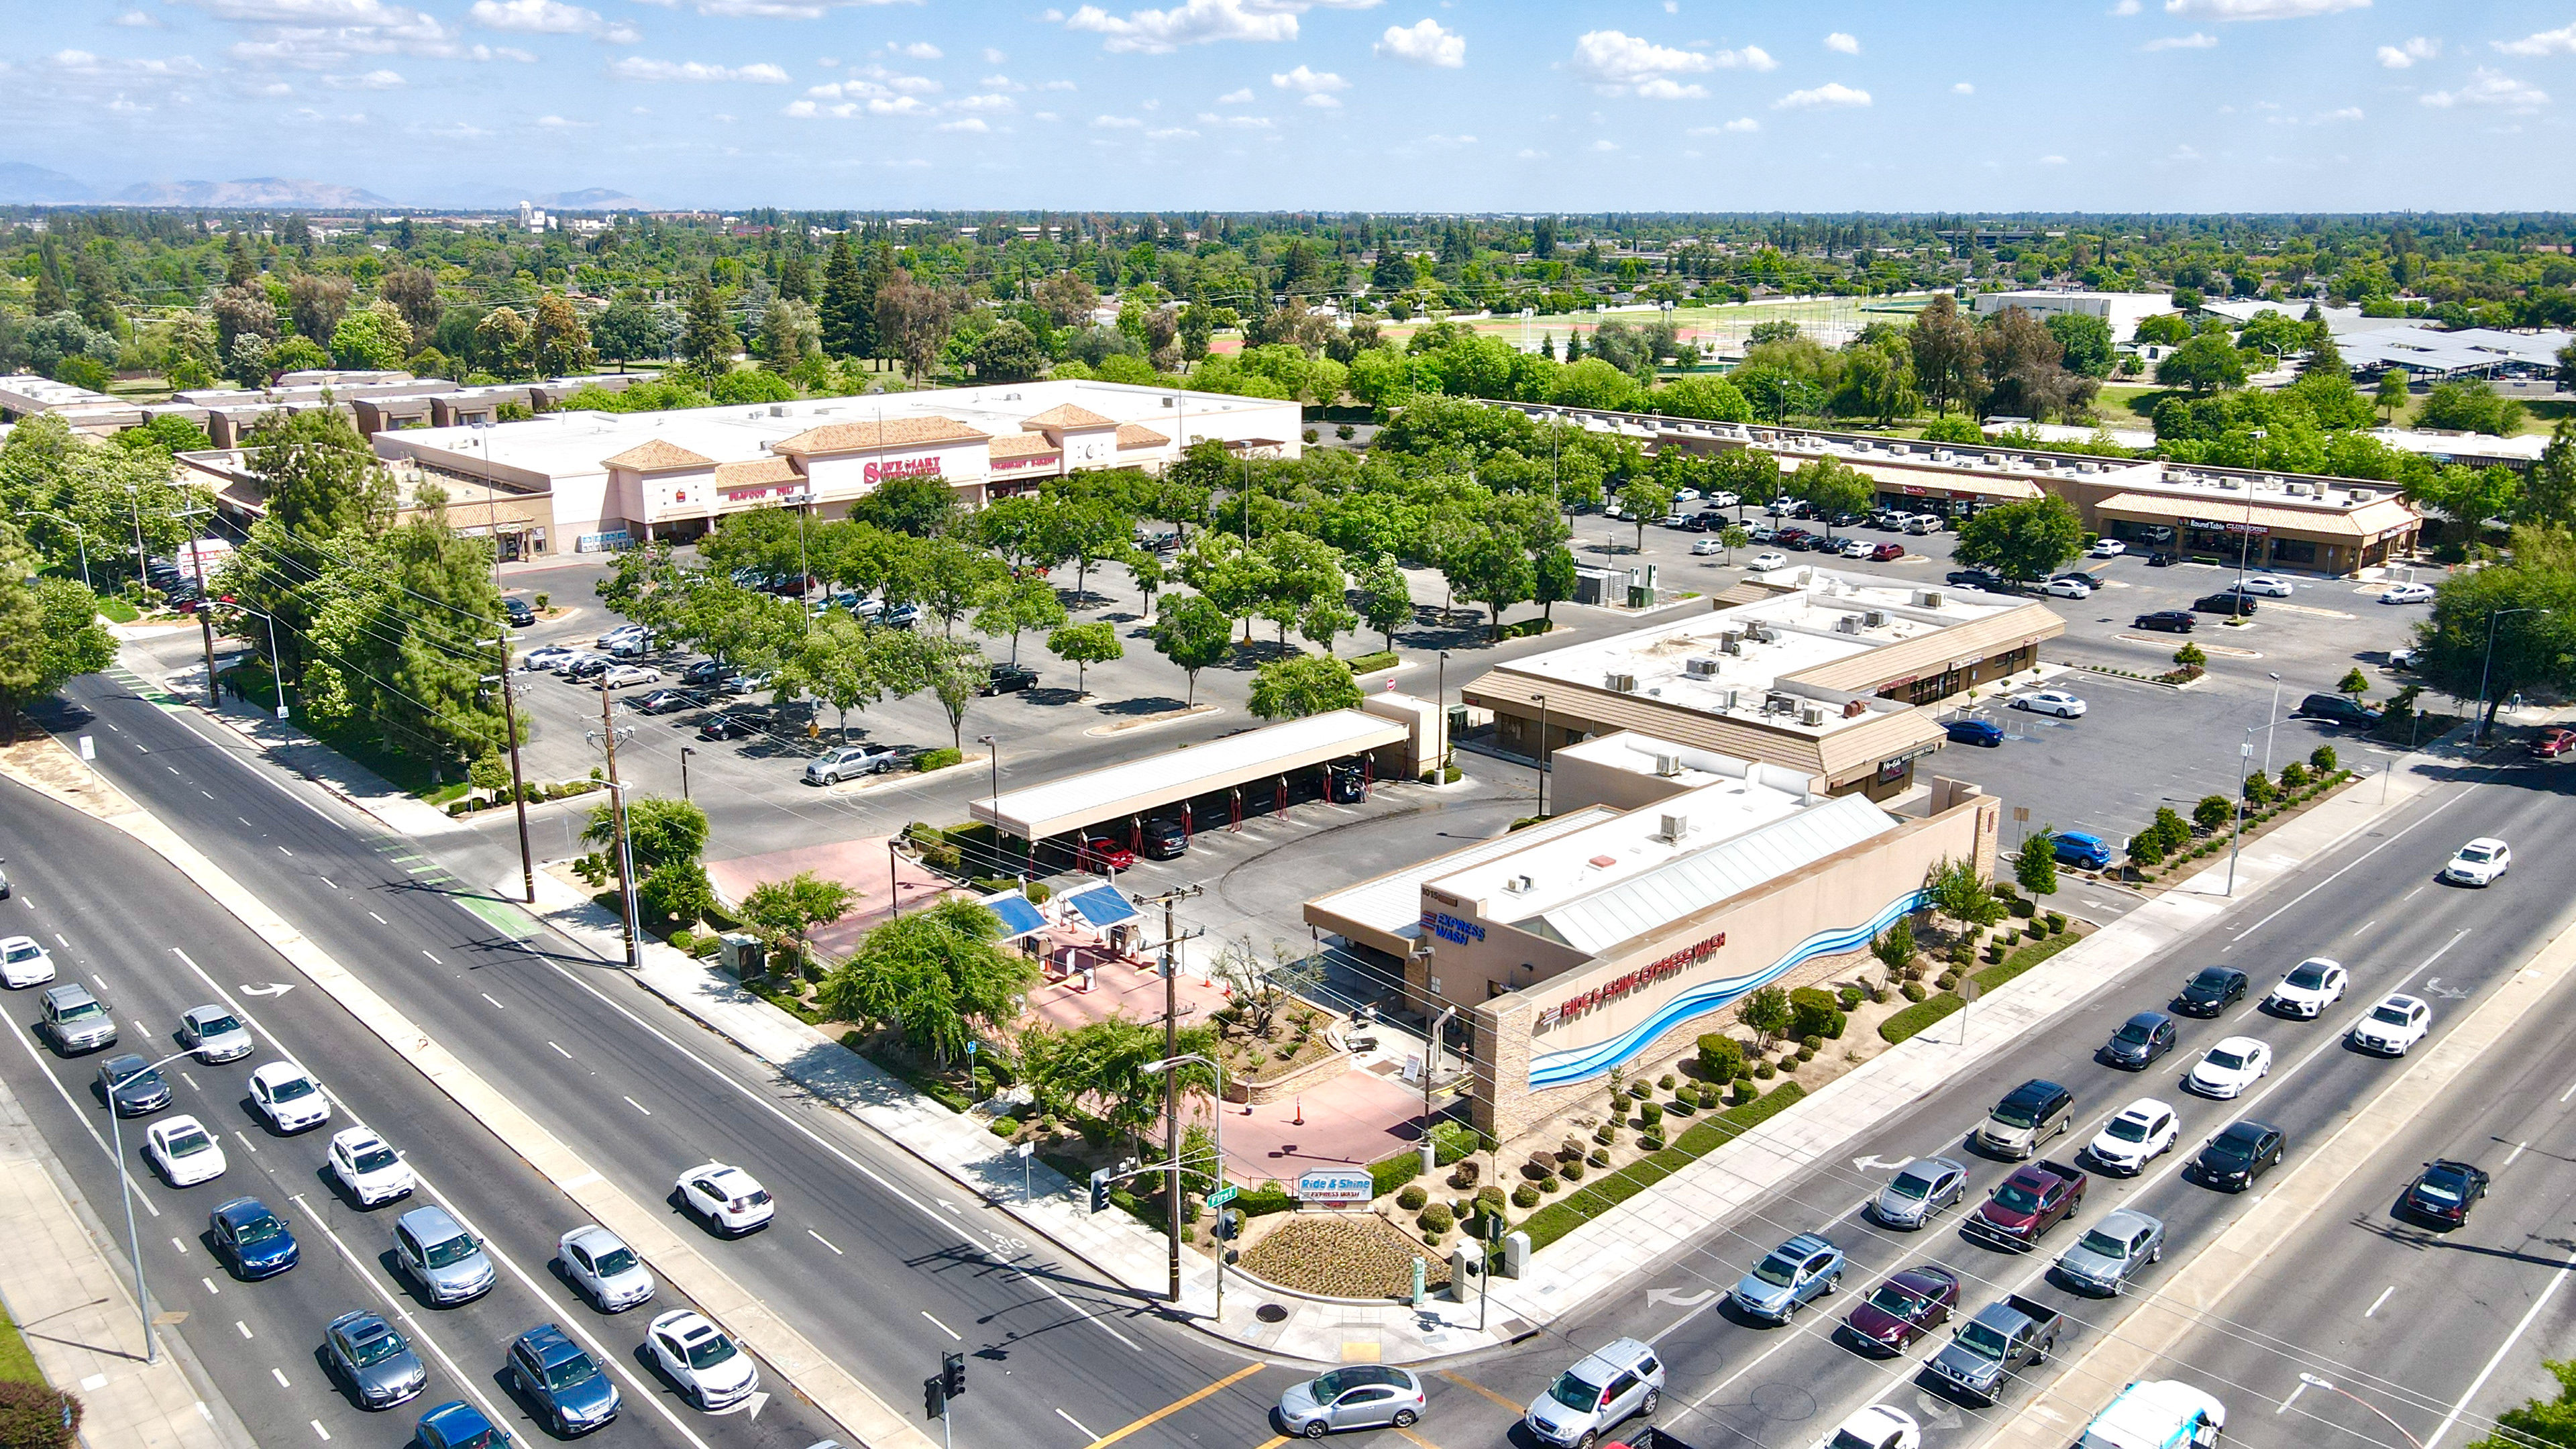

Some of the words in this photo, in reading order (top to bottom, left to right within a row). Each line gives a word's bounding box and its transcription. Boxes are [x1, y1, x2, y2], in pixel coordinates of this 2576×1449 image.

[863, 460, 902, 484] SAVE
[905, 457, 941, 471] MART
[2190, 519, 2209, 528] Round
[2210, 521, 2225, 530] Table
[1421, 888, 1438, 899] 1015
[1436, 925, 1469, 945] WASH
[1438, 913, 1486, 941] EXPRESS
[1562, 991, 1593, 1018] RIDE
[1593, 987, 1603, 1004] &
[1604, 970, 1640, 1000] SHINE
[1641, 947, 1693, 983] EXPRESS
[1693, 931, 1726, 959] WASH
[1302, 1179, 1327, 1188] Ride
[1329, 1179, 1337, 1189] &
[1338, 1179, 1370, 1189] Shine
[1212, 1188, 1233, 1205] First
